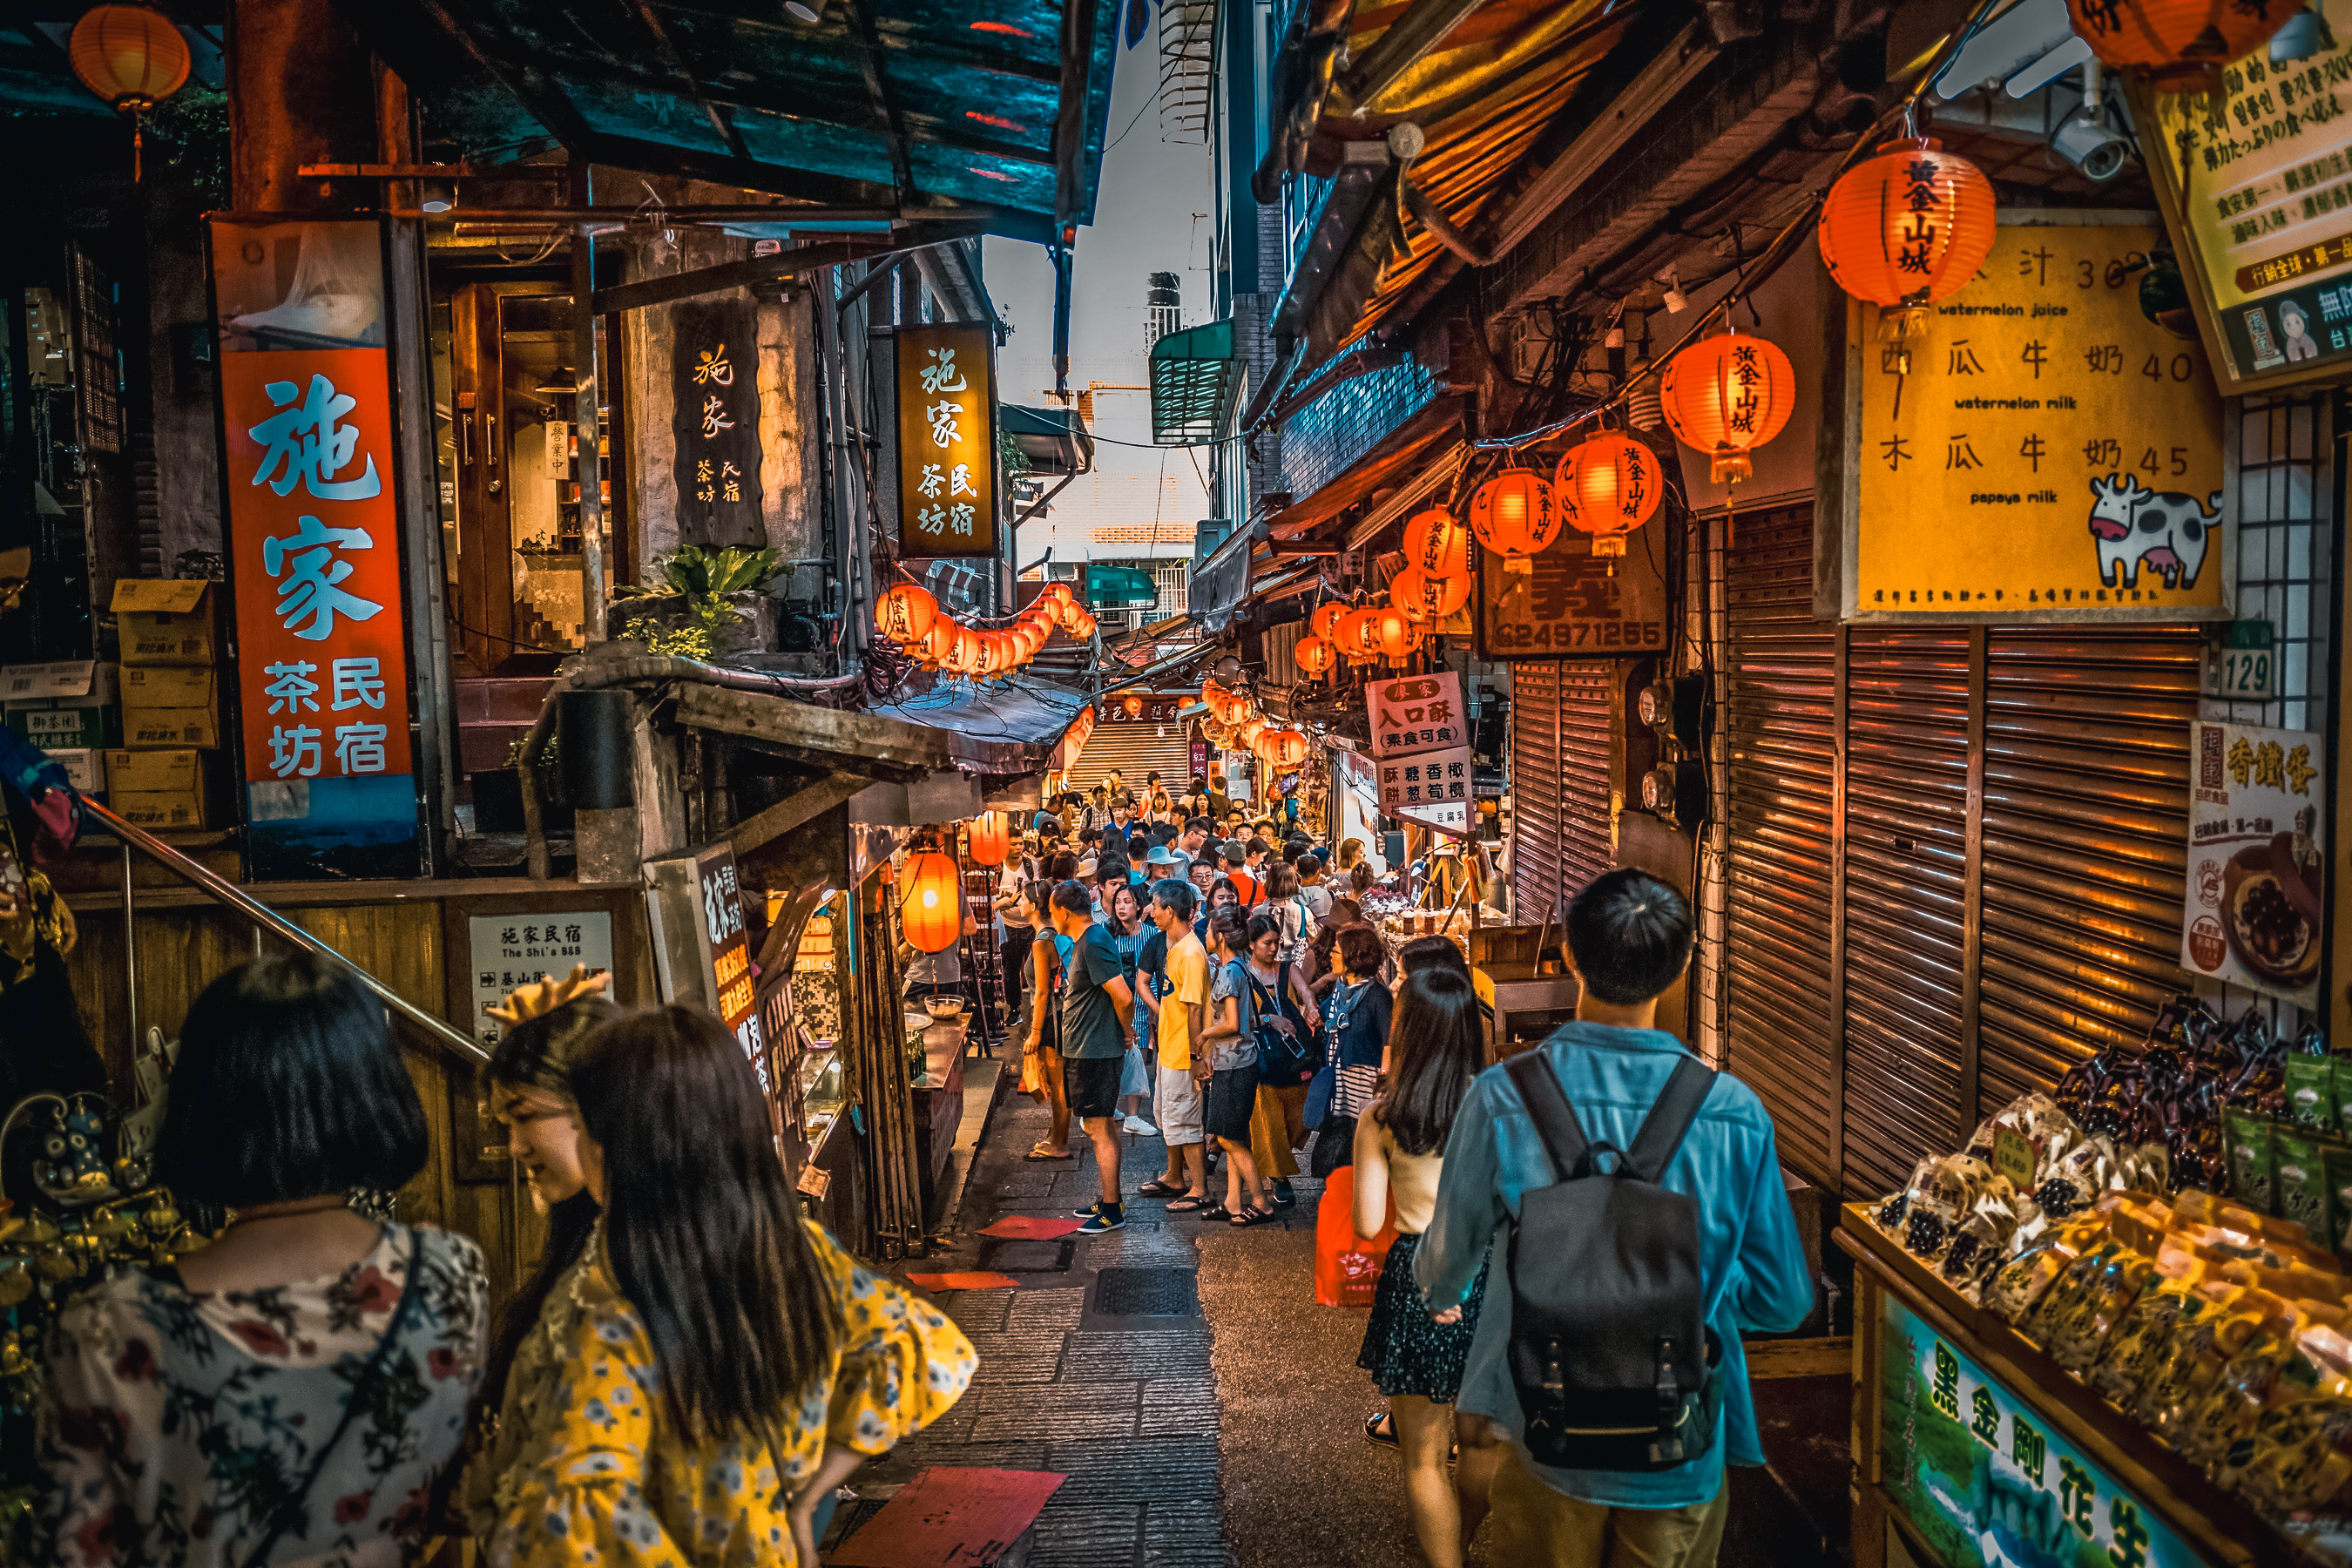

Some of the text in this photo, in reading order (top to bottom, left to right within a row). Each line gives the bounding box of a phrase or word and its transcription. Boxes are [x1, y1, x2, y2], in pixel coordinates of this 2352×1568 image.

[1938, 301, 2069, 320] watermelon juice
[2142, 352, 2193, 383] 40
[693, 343, 735, 439] 施家
[919, 348, 967, 449] 施家
[1954, 395, 2077, 411] watermelon milk
[549, 421, 564, 475] 營業中
[1879, 432, 2189, 476] 木瓜牛奶 45
[696, 459, 715, 504] 茶坊
[917, 463, 946, 537] 茶坊
[949, 463, 978, 537] 民宿
[1970, 490, 2058, 506] papaya milk
[249, 373, 383, 641] 施家
[1392, 681, 1434, 701] 廖家
[2226, 653, 2269, 691] 129
[264, 659, 321, 778] 茶坊
[330, 657, 387, 774] 民宿
[1378, 700, 1456, 729] 入口酥
[1380, 726, 1459, 748] (素食可食)
[500, 924, 582, 944] 施家民宿
[502, 946, 581, 958] The Shi's B&B
[500, 970, 547, 986] 基山街
